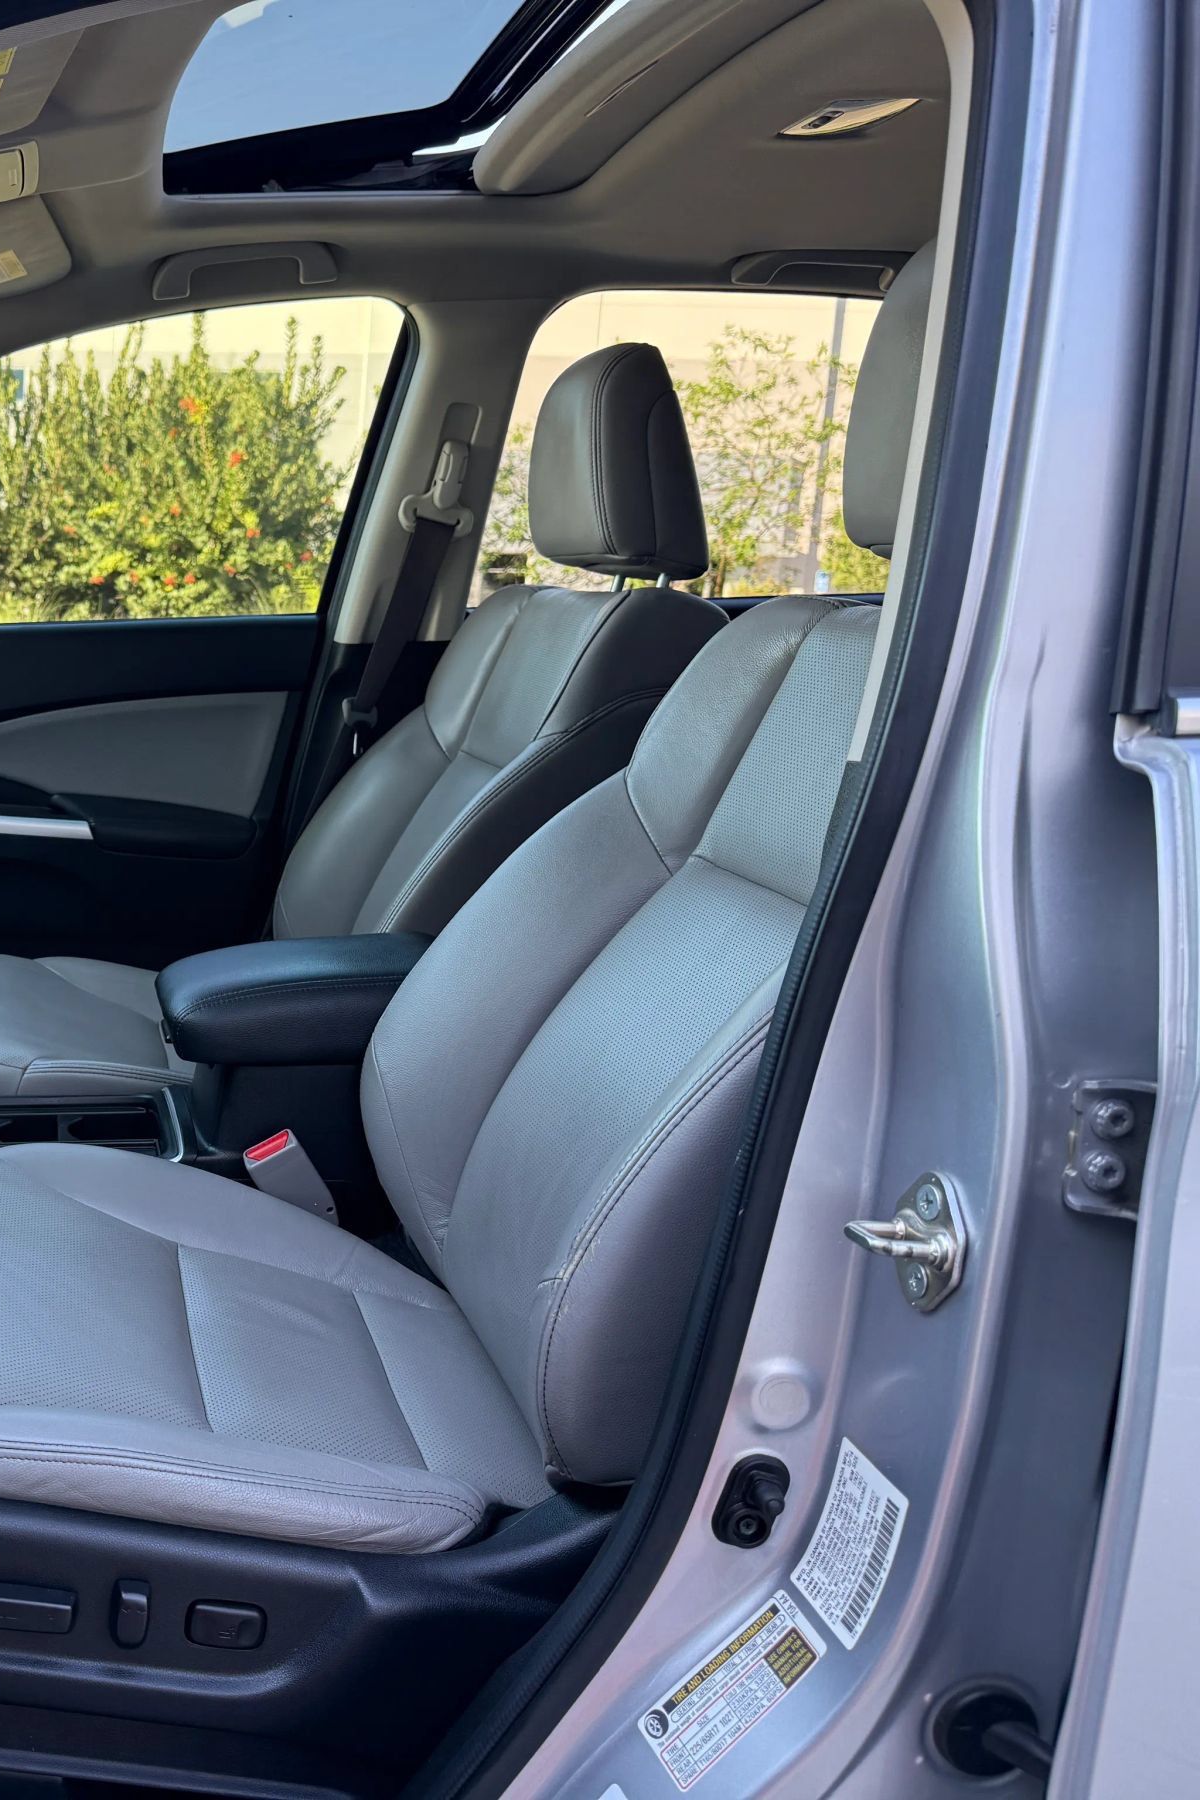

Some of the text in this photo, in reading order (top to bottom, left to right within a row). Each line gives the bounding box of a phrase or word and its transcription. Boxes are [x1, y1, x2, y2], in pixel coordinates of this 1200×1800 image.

[810, 1535, 822, 1558] CANADA
[825, 1503, 834, 1523] HONDA
[835, 1467, 844, 1491] CANADA
[805, 1551, 821, 1577] DIVISION
[824, 1518, 835, 1539] HONDA
[833, 1491, 843, 1515] CANADA
[671, 1687, 687, 1704] TIRE
[686, 1674, 701, 1691] AND
[700, 1648, 729, 1678] LOADING
[728, 1609, 773, 1653] INFORMATION
[676, 1697, 694, 1717] SEATING
[695, 1677, 716, 1699] CAPACITY
[667, 1743, 678, 1756] TIRE
[696, 1714, 709, 1727] SIZE
[690, 1710, 734, 1756] 225/65R17 102T
[670, 1749, 685, 1766] FRONT
[676, 1758, 691, 1774] REAR
[681, 1766, 697, 1784] SPARE
